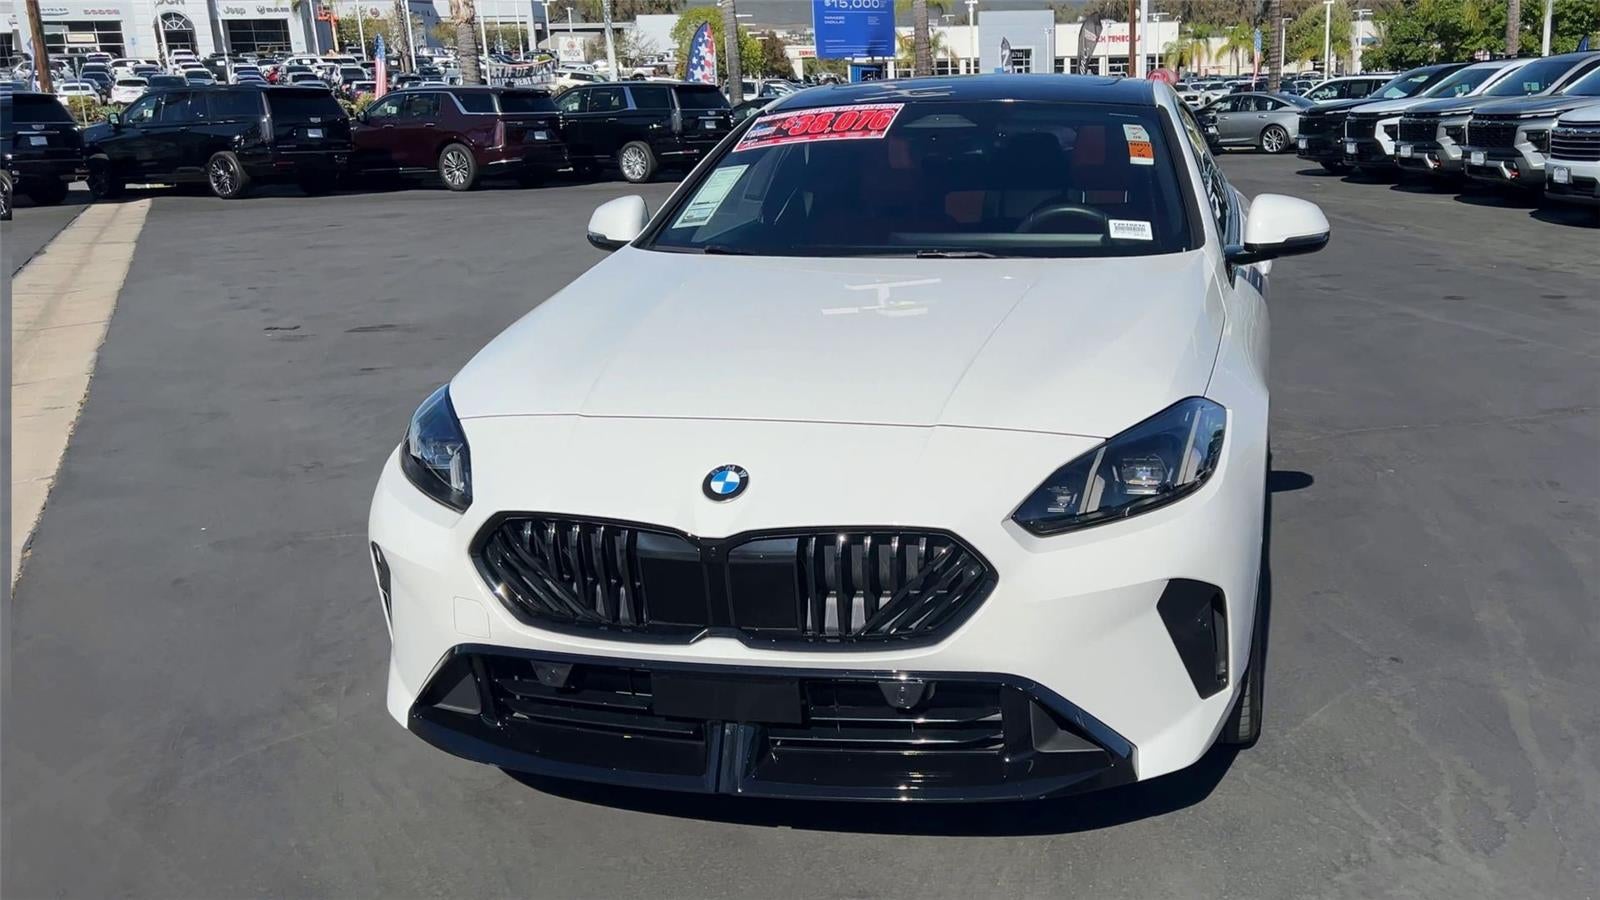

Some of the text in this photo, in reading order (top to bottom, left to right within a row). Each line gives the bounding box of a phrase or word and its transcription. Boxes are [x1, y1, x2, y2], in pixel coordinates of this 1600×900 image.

[223, 6, 247, 15] Jeep
[781, 109, 896, 136] $38,076
[711, 465, 747, 478] BMW
